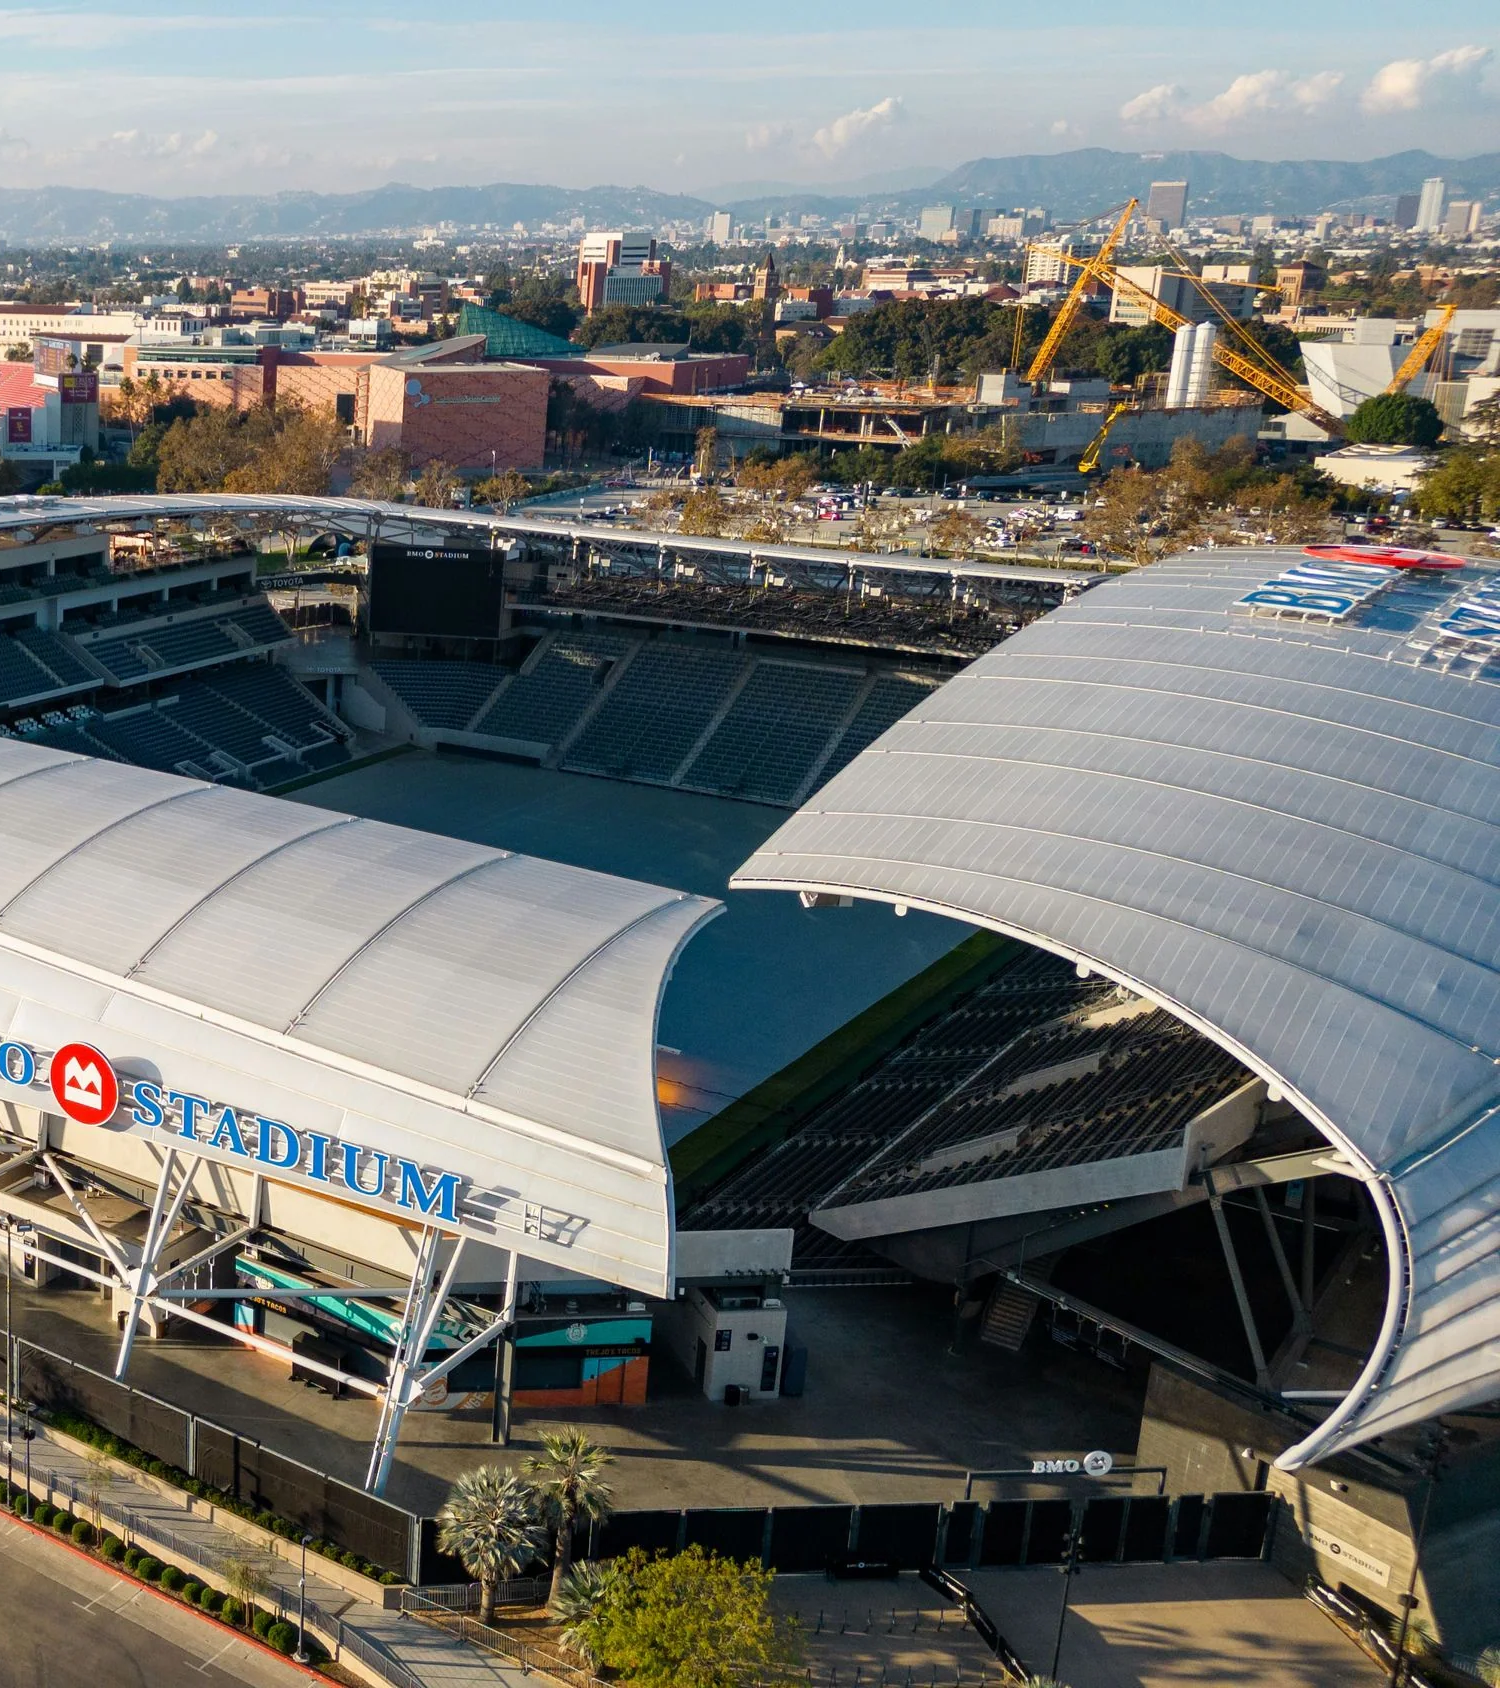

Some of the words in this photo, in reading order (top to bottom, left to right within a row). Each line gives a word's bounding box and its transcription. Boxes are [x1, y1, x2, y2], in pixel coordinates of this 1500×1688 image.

[272, 576, 304, 588] TOYOTA
[1234, 560, 1405, 618] BMO
[131, 1080, 462, 1223] STADIUM
[266, 1300, 287, 1314] TACOS
[1031, 1459, 1080, 1473] BMO
[1308, 1532, 1329, 1546] BMO
[1341, 1551, 1384, 1577] STADIUM
